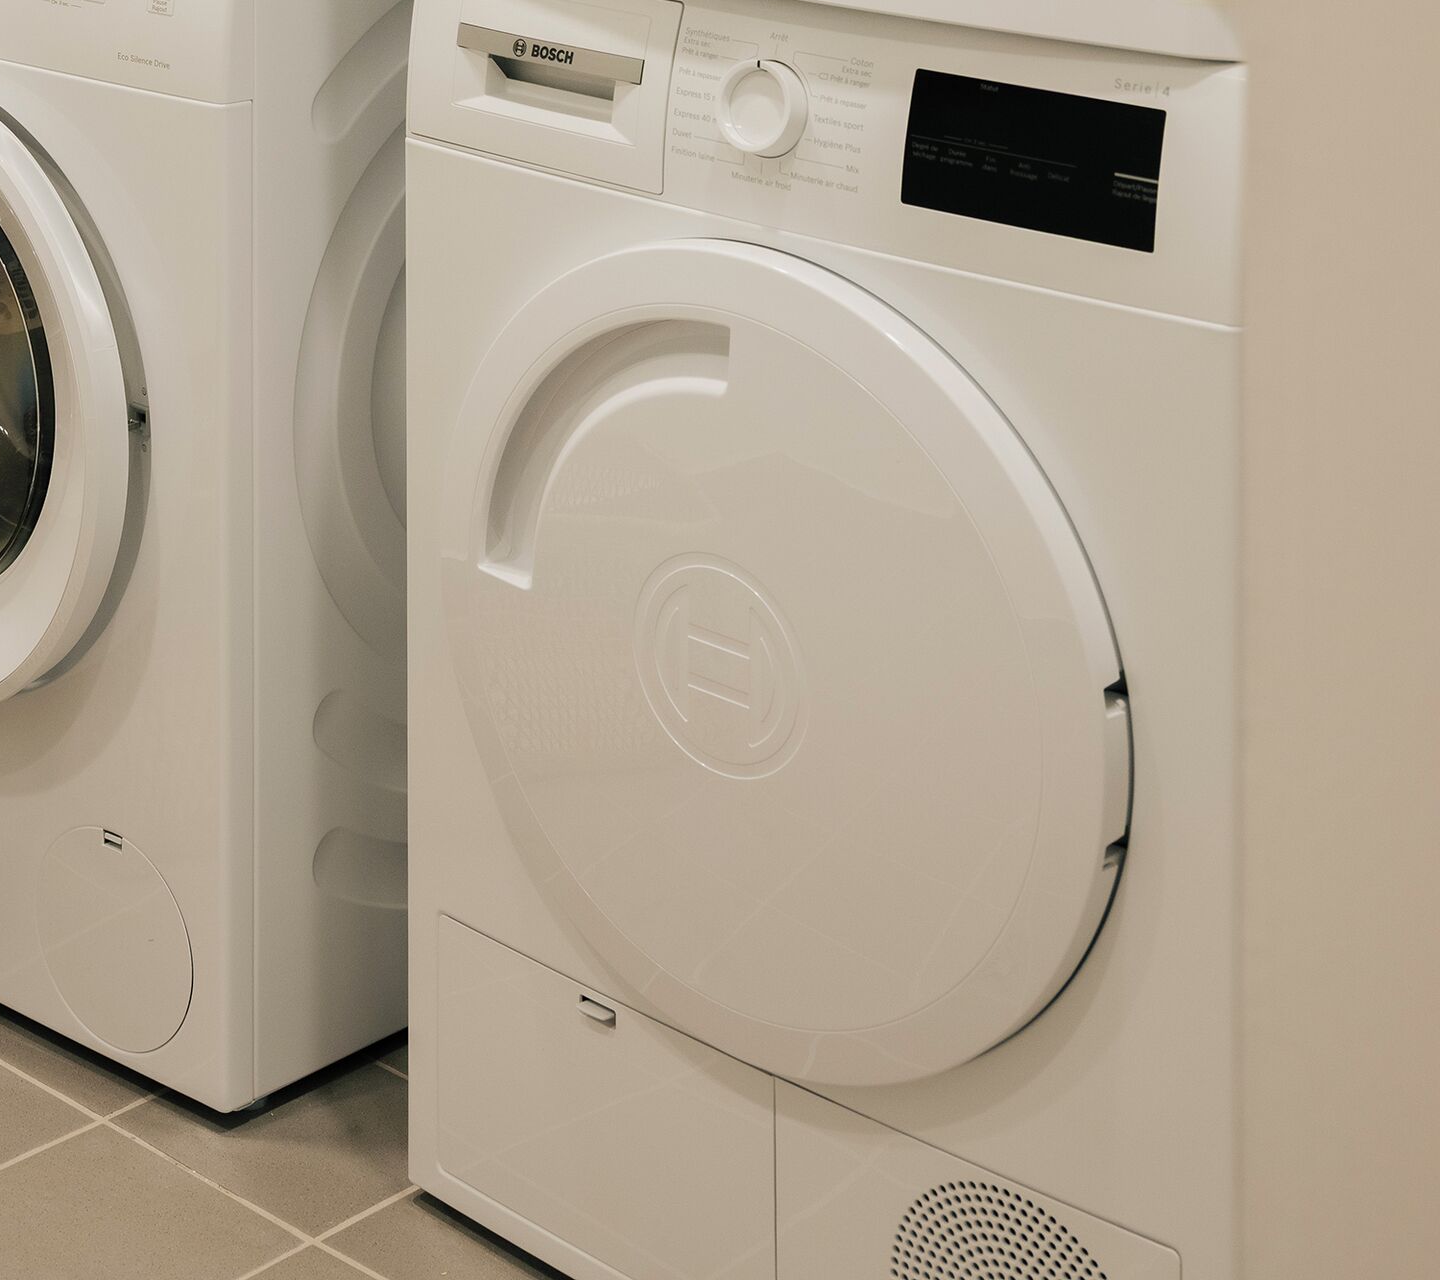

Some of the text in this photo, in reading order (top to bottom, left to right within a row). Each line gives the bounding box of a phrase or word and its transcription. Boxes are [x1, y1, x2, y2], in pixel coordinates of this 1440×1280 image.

[152, 0, 168, 7] Pause
[685, 27, 730, 42] Synthétiques
[770, 32, 789, 42] Arrêt
[684, 37, 711, 48] Extra sec
[118, 52, 170, 70] Eco Silence Drive
[531, 44, 575, 65] BOSCH
[850, 57, 874, 68] Coton
[841, 66, 872, 78] Extra sec
[849, 78, 871, 88] ranger
[1114, 78, 1170, 96] Serie 4
[676, 87, 702, 100] Express
[674, 109, 701, 122] Express
[813, 114, 864, 132] Textiles sport
[672, 128, 692, 139] Duvet
[813, 135, 861, 153] Hygiène Plus
[672, 146, 697, 158] Finition
[846, 164, 860, 174] Mix
[731, 171, 791, 191] Minuterie air froid
[791, 172, 858, 192] Minuterie air chaud
